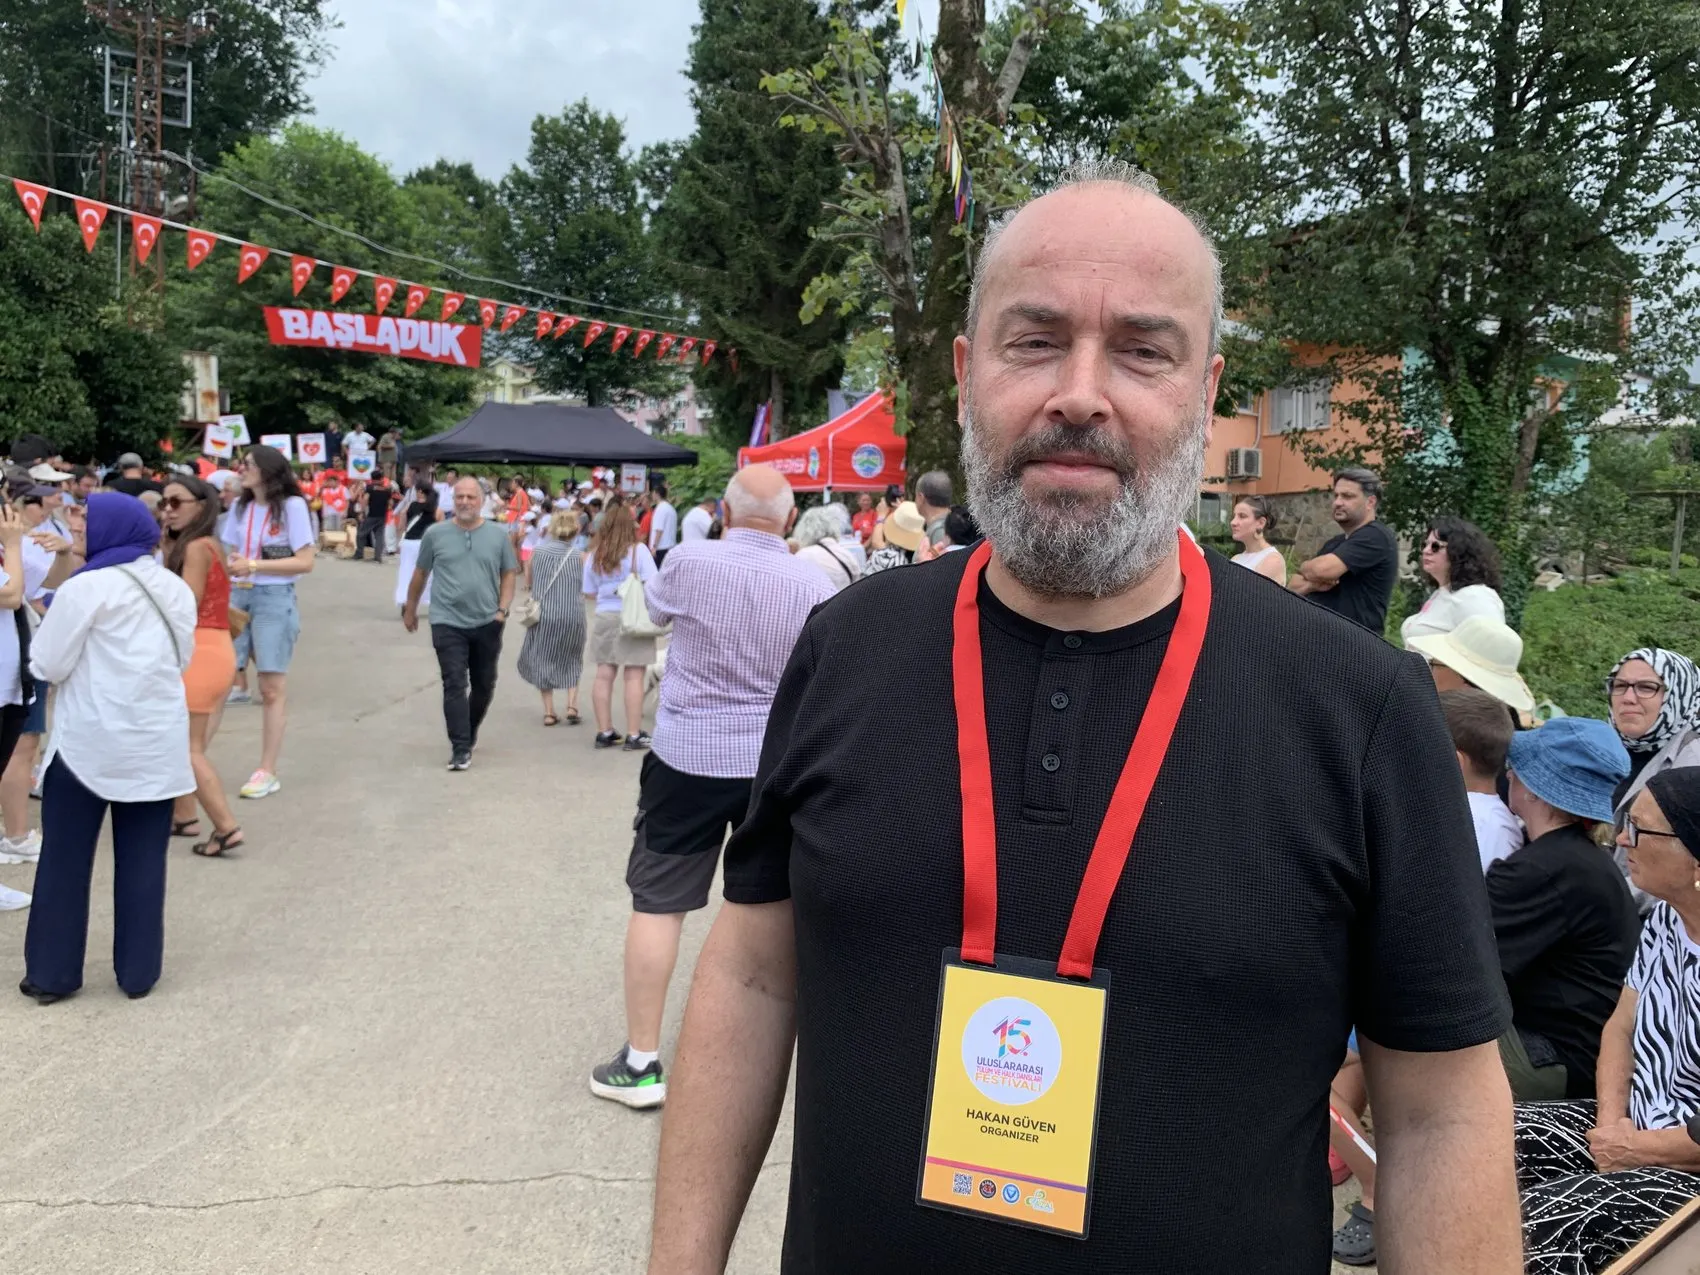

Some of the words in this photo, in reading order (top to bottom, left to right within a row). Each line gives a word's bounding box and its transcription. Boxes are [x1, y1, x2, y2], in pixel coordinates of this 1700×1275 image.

[278, 308, 467, 365] BAŞLADUK
[992, 1017, 1032, 1058] 15.
[976, 1056, 1044, 1076] ULUSLARARASI
[966, 1108, 1010, 1126] HAKAN
[1013, 1115, 1056, 1134] GÜVEN
[980, 1125, 1039, 1143] ORGANIZER
